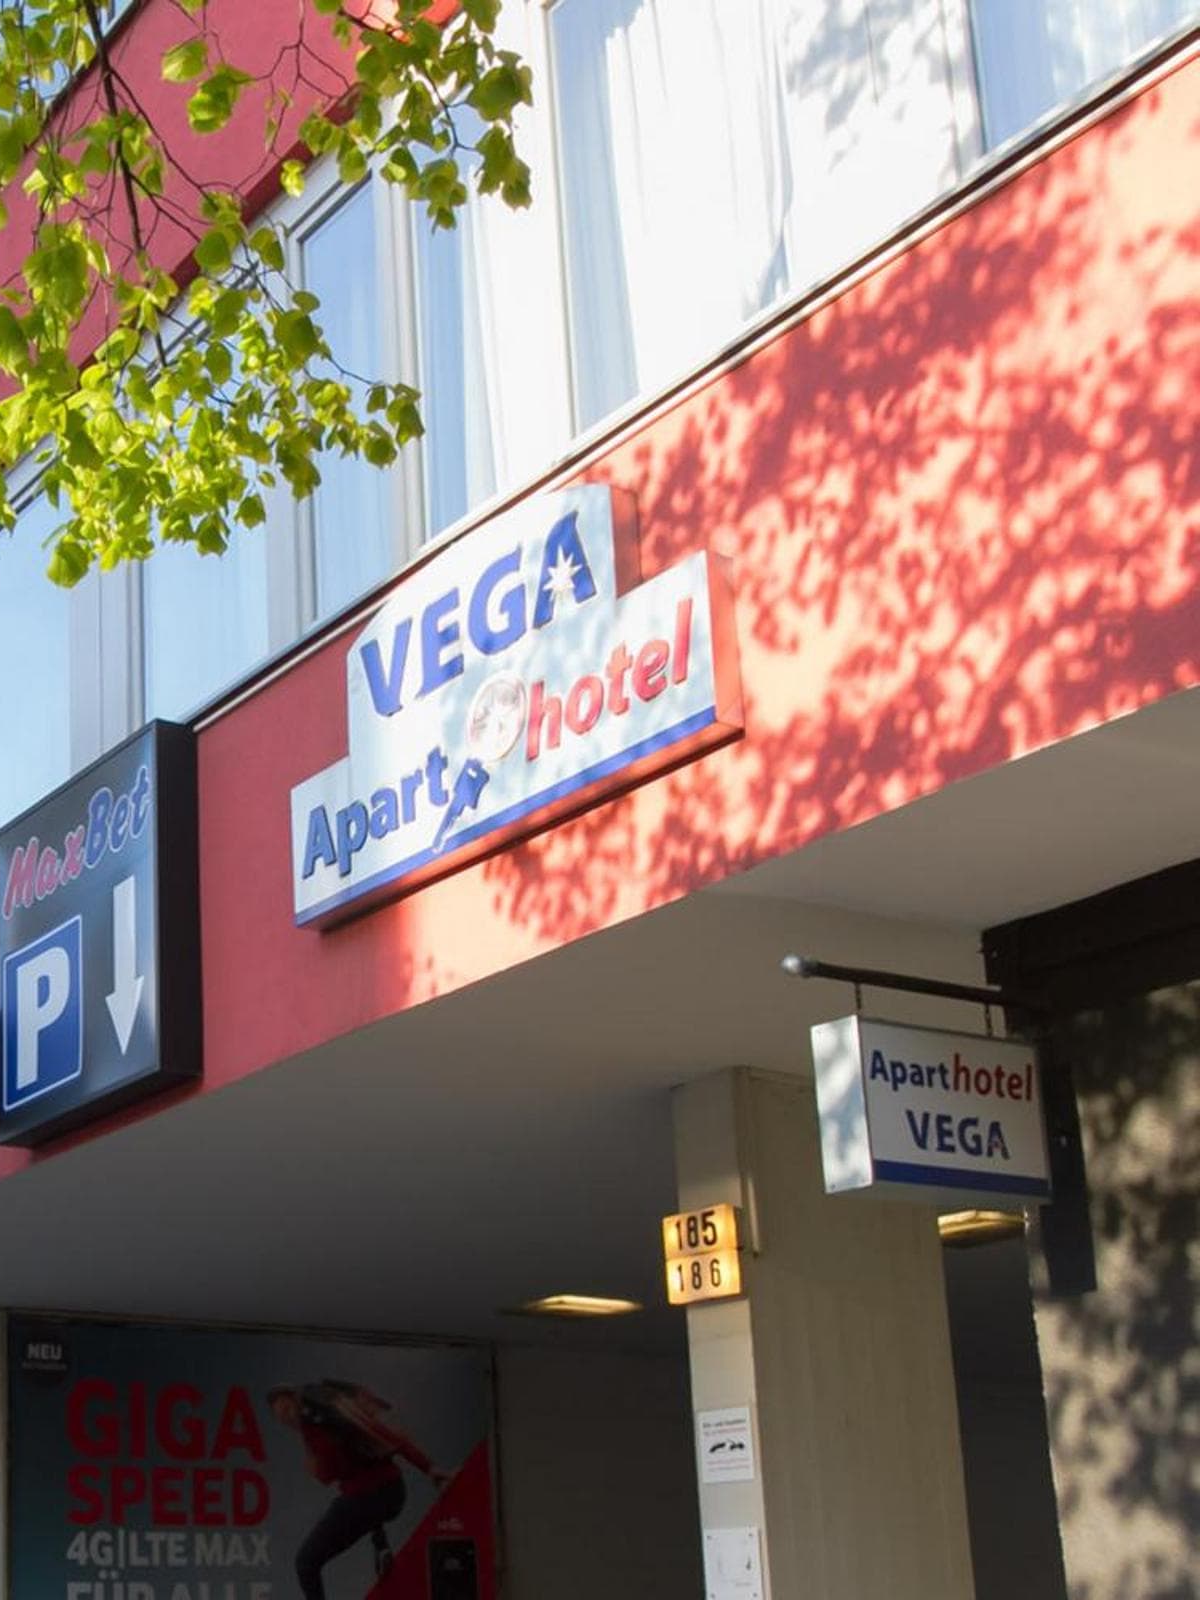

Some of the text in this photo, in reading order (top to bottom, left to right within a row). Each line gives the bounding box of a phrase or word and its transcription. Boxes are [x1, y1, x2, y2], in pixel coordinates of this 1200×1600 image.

[359, 511, 597, 718] VEGA
[302, 597, 693, 880] Apart hotel
[3, 766, 151, 920] MaxBet
[16, 946, 71, 1090] P
[869, 1049, 1032, 1102] Aparthotel
[905, 1109, 1010, 1160] VEGA
[675, 1210, 718, 1251] 185
[676, 1259, 722, 1292] 186
[27, 1343, 63, 1360] NEU
[65, 1375, 268, 1463] GIGA
[66, 1463, 271, 1527] SPEED
[194, 1531, 272, 1566] MAX
